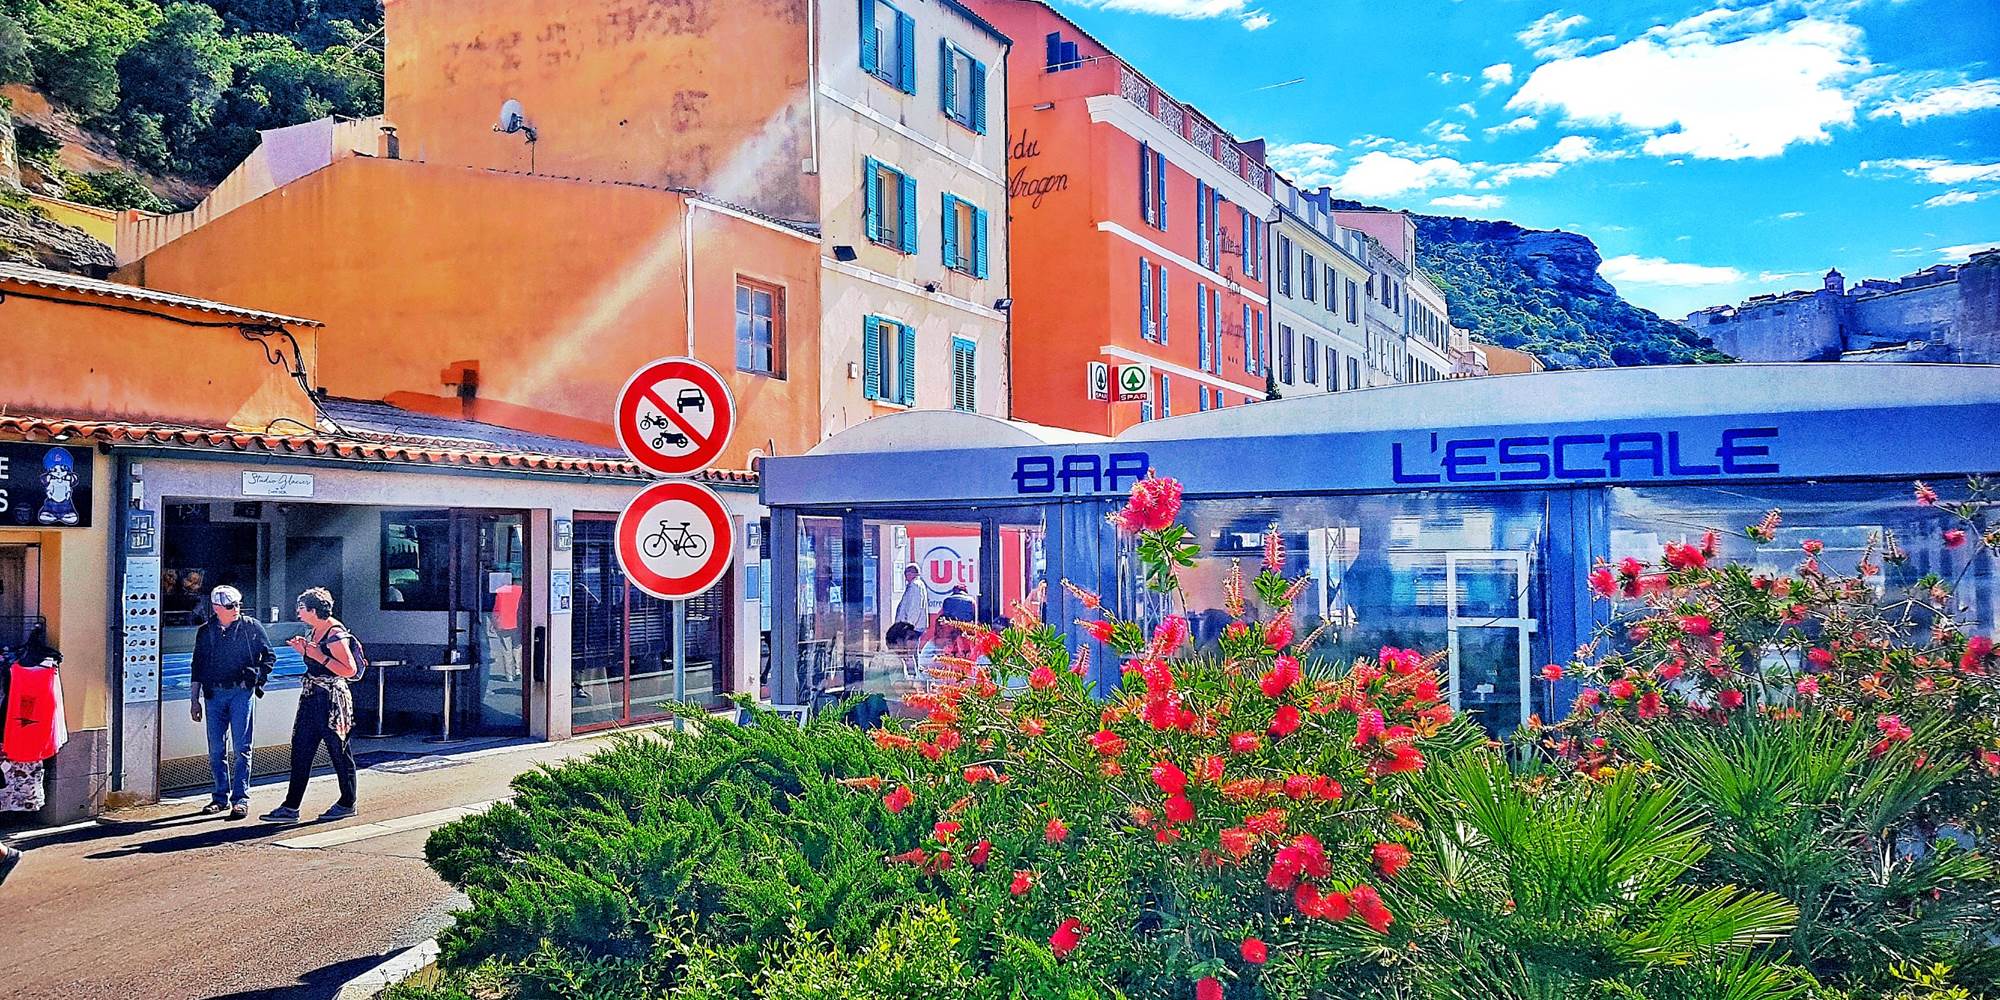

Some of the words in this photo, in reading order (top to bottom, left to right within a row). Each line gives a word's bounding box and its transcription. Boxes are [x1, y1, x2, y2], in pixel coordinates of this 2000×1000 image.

[1012, 128, 1040, 160] du
[1120, 393, 1147, 401] SPAR
[1011, 451, 1149, 494] BAR
[1391, 427, 1780, 484] L'ESCALE
